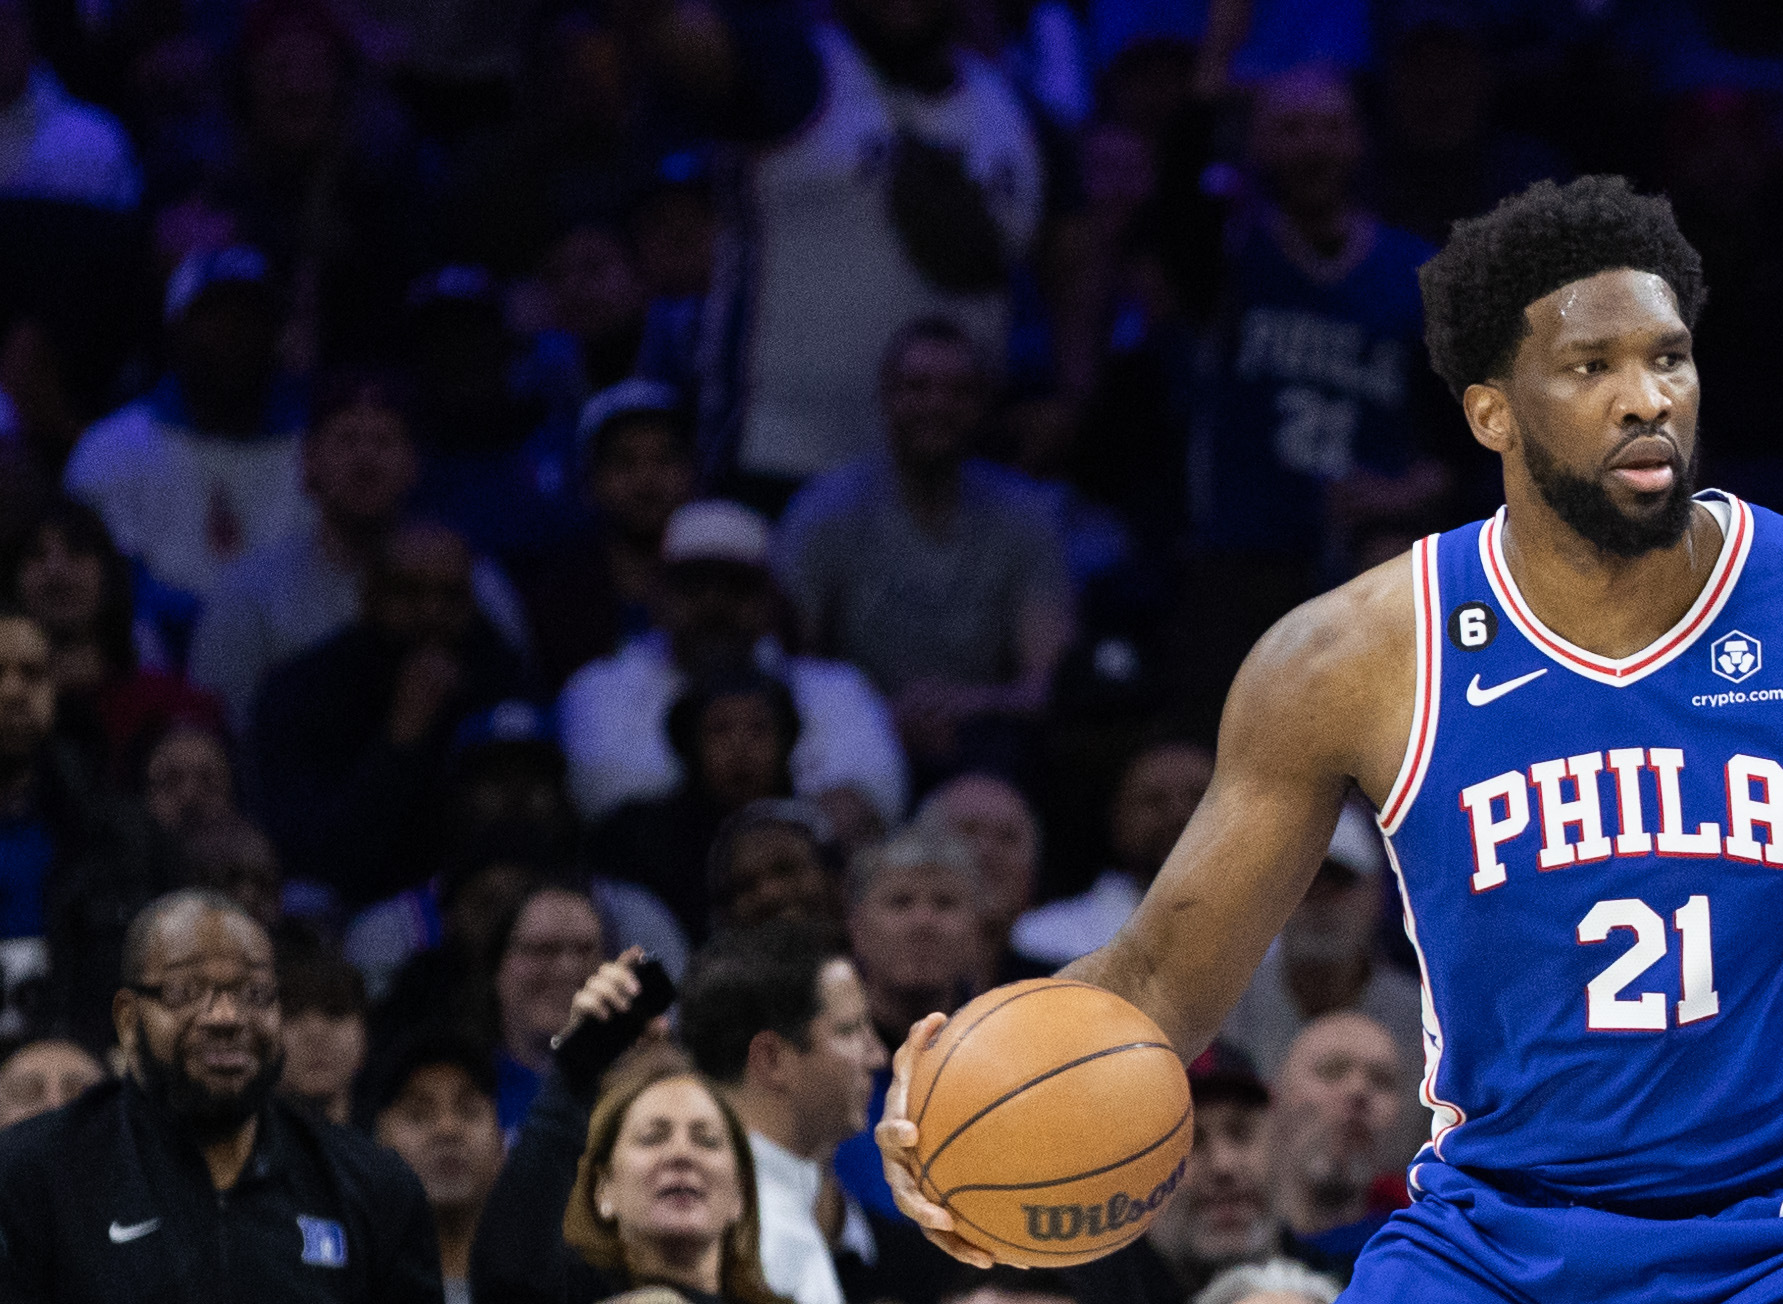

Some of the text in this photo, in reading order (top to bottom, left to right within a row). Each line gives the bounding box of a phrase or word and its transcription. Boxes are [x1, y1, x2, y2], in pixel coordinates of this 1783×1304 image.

[1456, 608, 1488, 647] 6
[1576, 894, 1720, 1032] 21
[1020, 1155, 1187, 1242] Wilson
